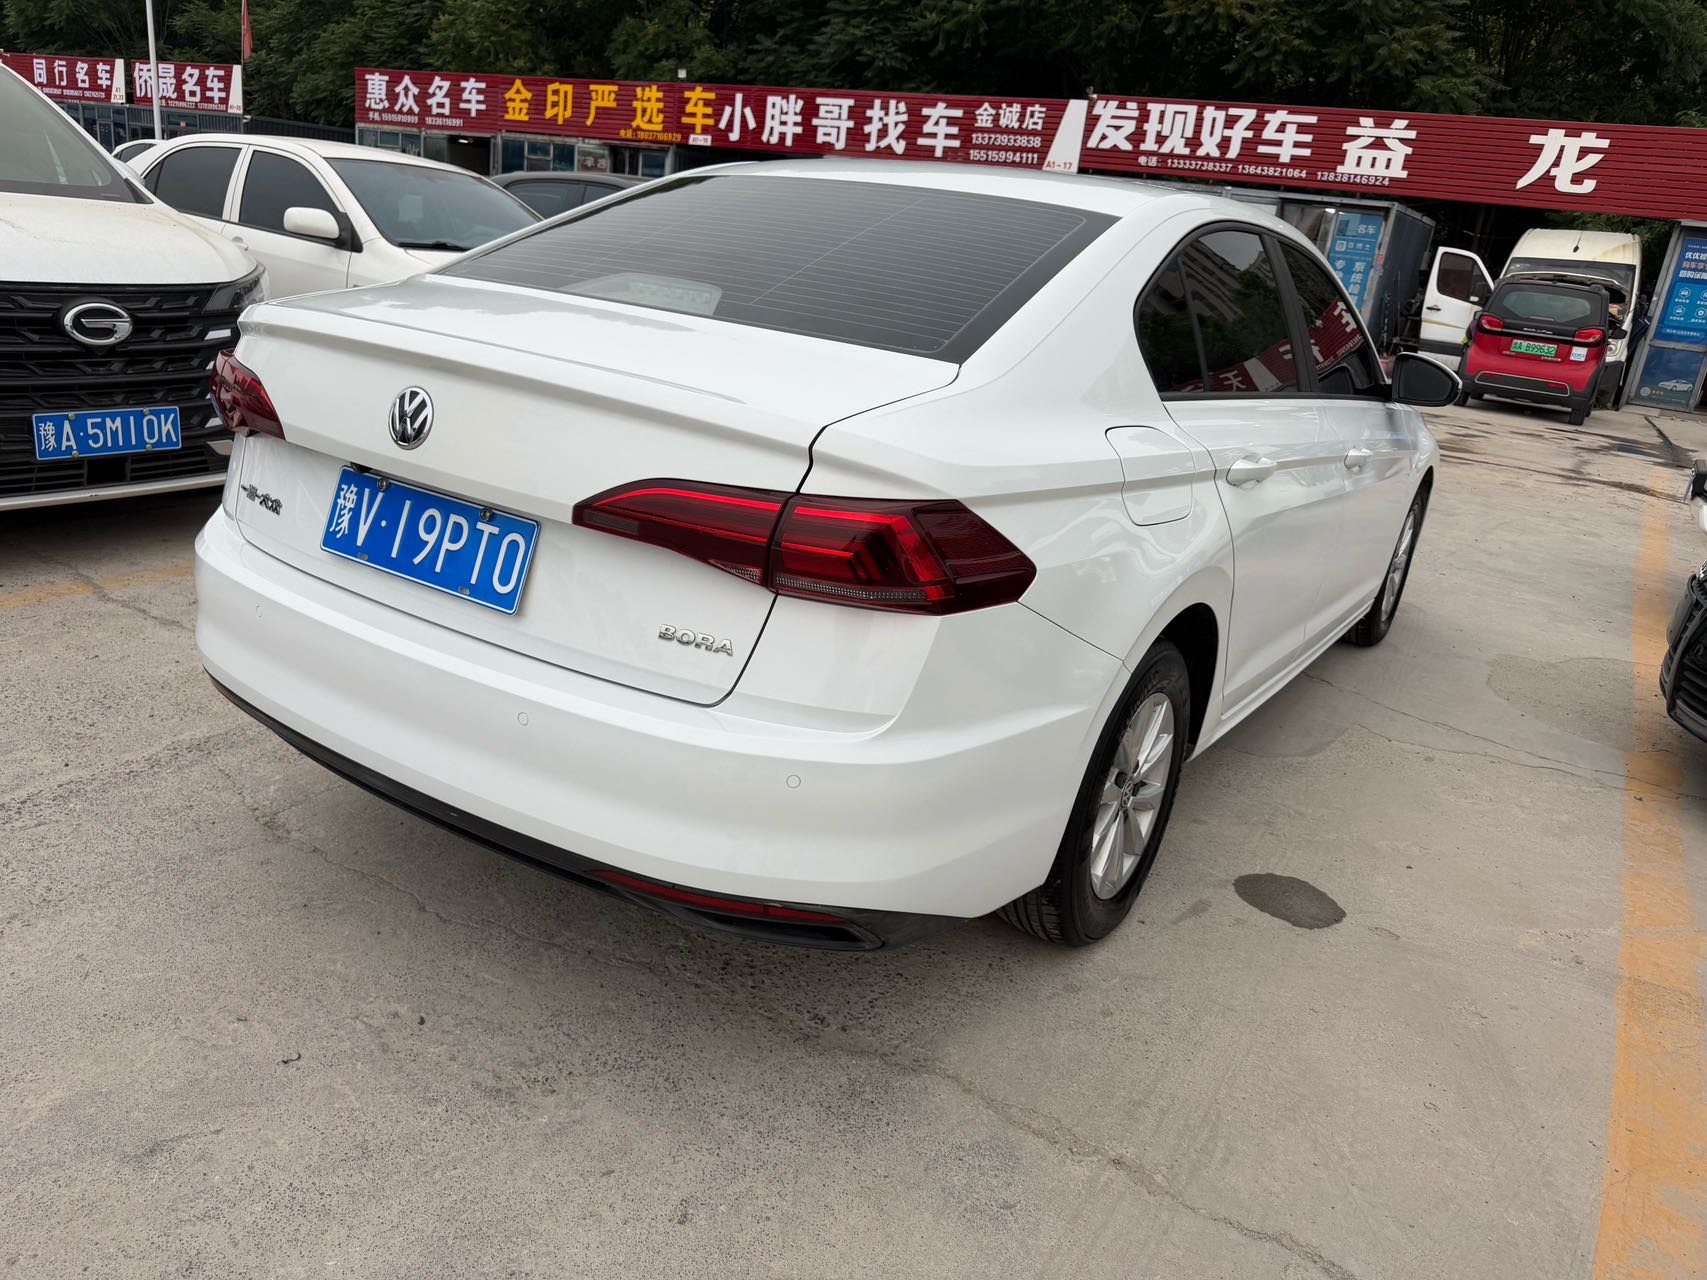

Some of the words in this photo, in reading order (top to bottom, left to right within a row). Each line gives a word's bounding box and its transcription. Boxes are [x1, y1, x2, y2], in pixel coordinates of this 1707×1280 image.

[33, 58, 112, 88] 同行名车
[365, 72, 487, 117] 惠众名车
[504, 79, 716, 134] 金印严选车
[718, 93, 964, 158] 小胖哥找车
[974, 102, 1047, 130] 金诚店
[1087, 100, 1318, 163] 发现好车
[969, 149, 1039, 164] 15515994111
[971, 133, 1042, 148] 13373933838
[1166, 158, 1232, 173] 13333738337
[1237, 164, 1307, 179] 13643821064
[1316, 171, 1390, 186] 13838146924
[329, 484, 526, 594] 豫V·19PT0
[658, 624, 733, 656] BORA
